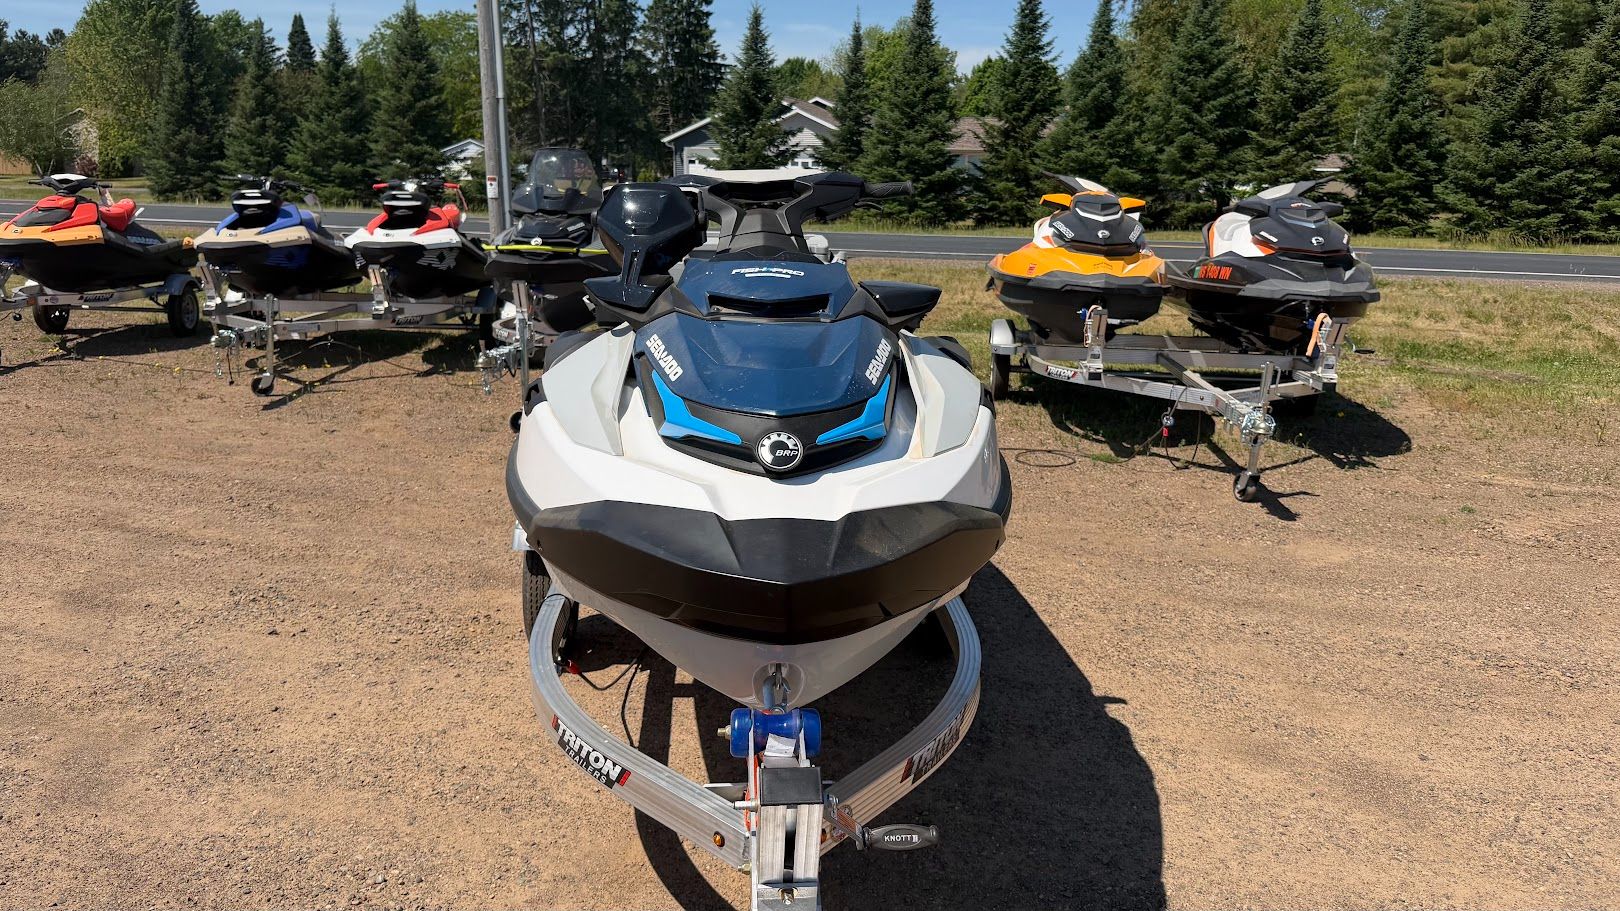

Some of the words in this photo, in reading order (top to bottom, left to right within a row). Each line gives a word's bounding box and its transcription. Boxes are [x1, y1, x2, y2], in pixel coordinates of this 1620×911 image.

[770, 267, 805, 277] PRO
[775, 449, 799, 457] BRP
[557, 719, 622, 781] TRITON
[565, 744, 607, 784] TRAILERS
[884, 834, 912, 842] KNOTT
